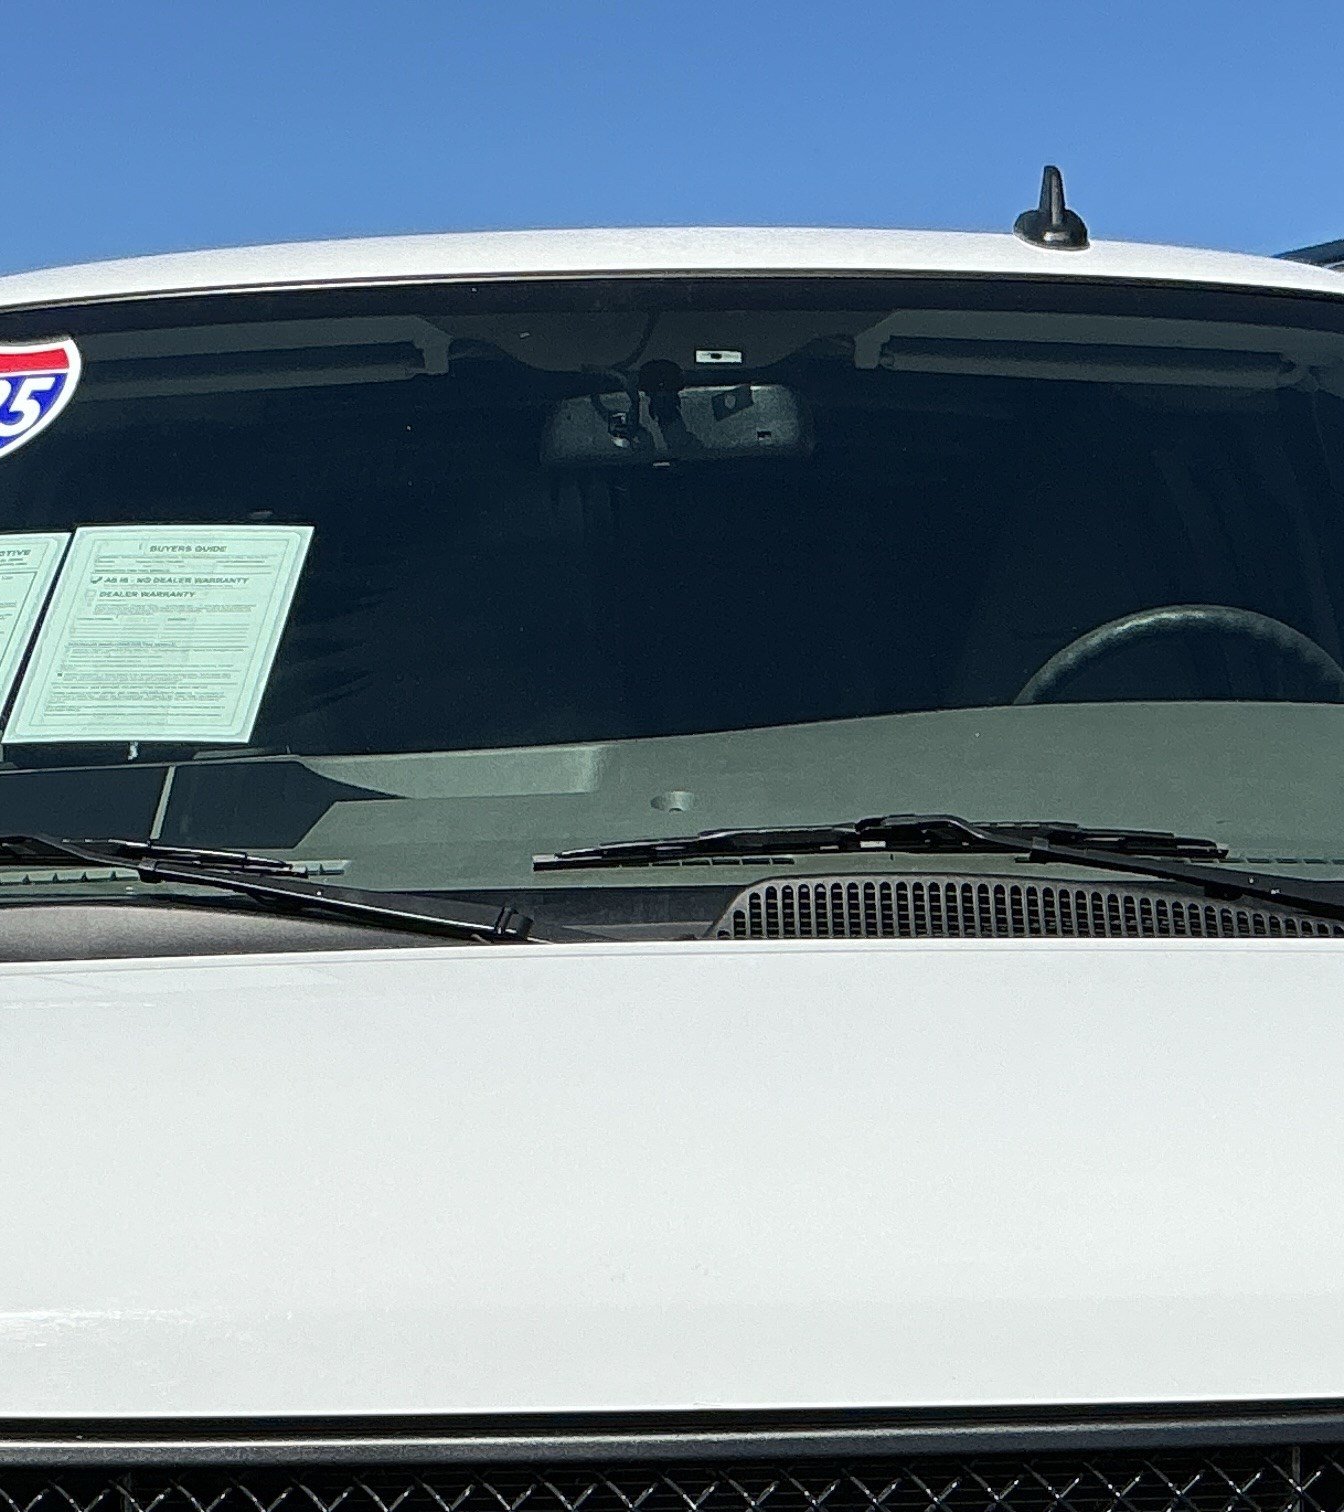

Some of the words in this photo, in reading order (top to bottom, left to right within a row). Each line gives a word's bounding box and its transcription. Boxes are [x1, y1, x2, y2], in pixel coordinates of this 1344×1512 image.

[149, 545, 192, 553] BUYERS
[195, 545, 227, 553] GUIDE
[194, 577, 249, 585] WARRANTY
